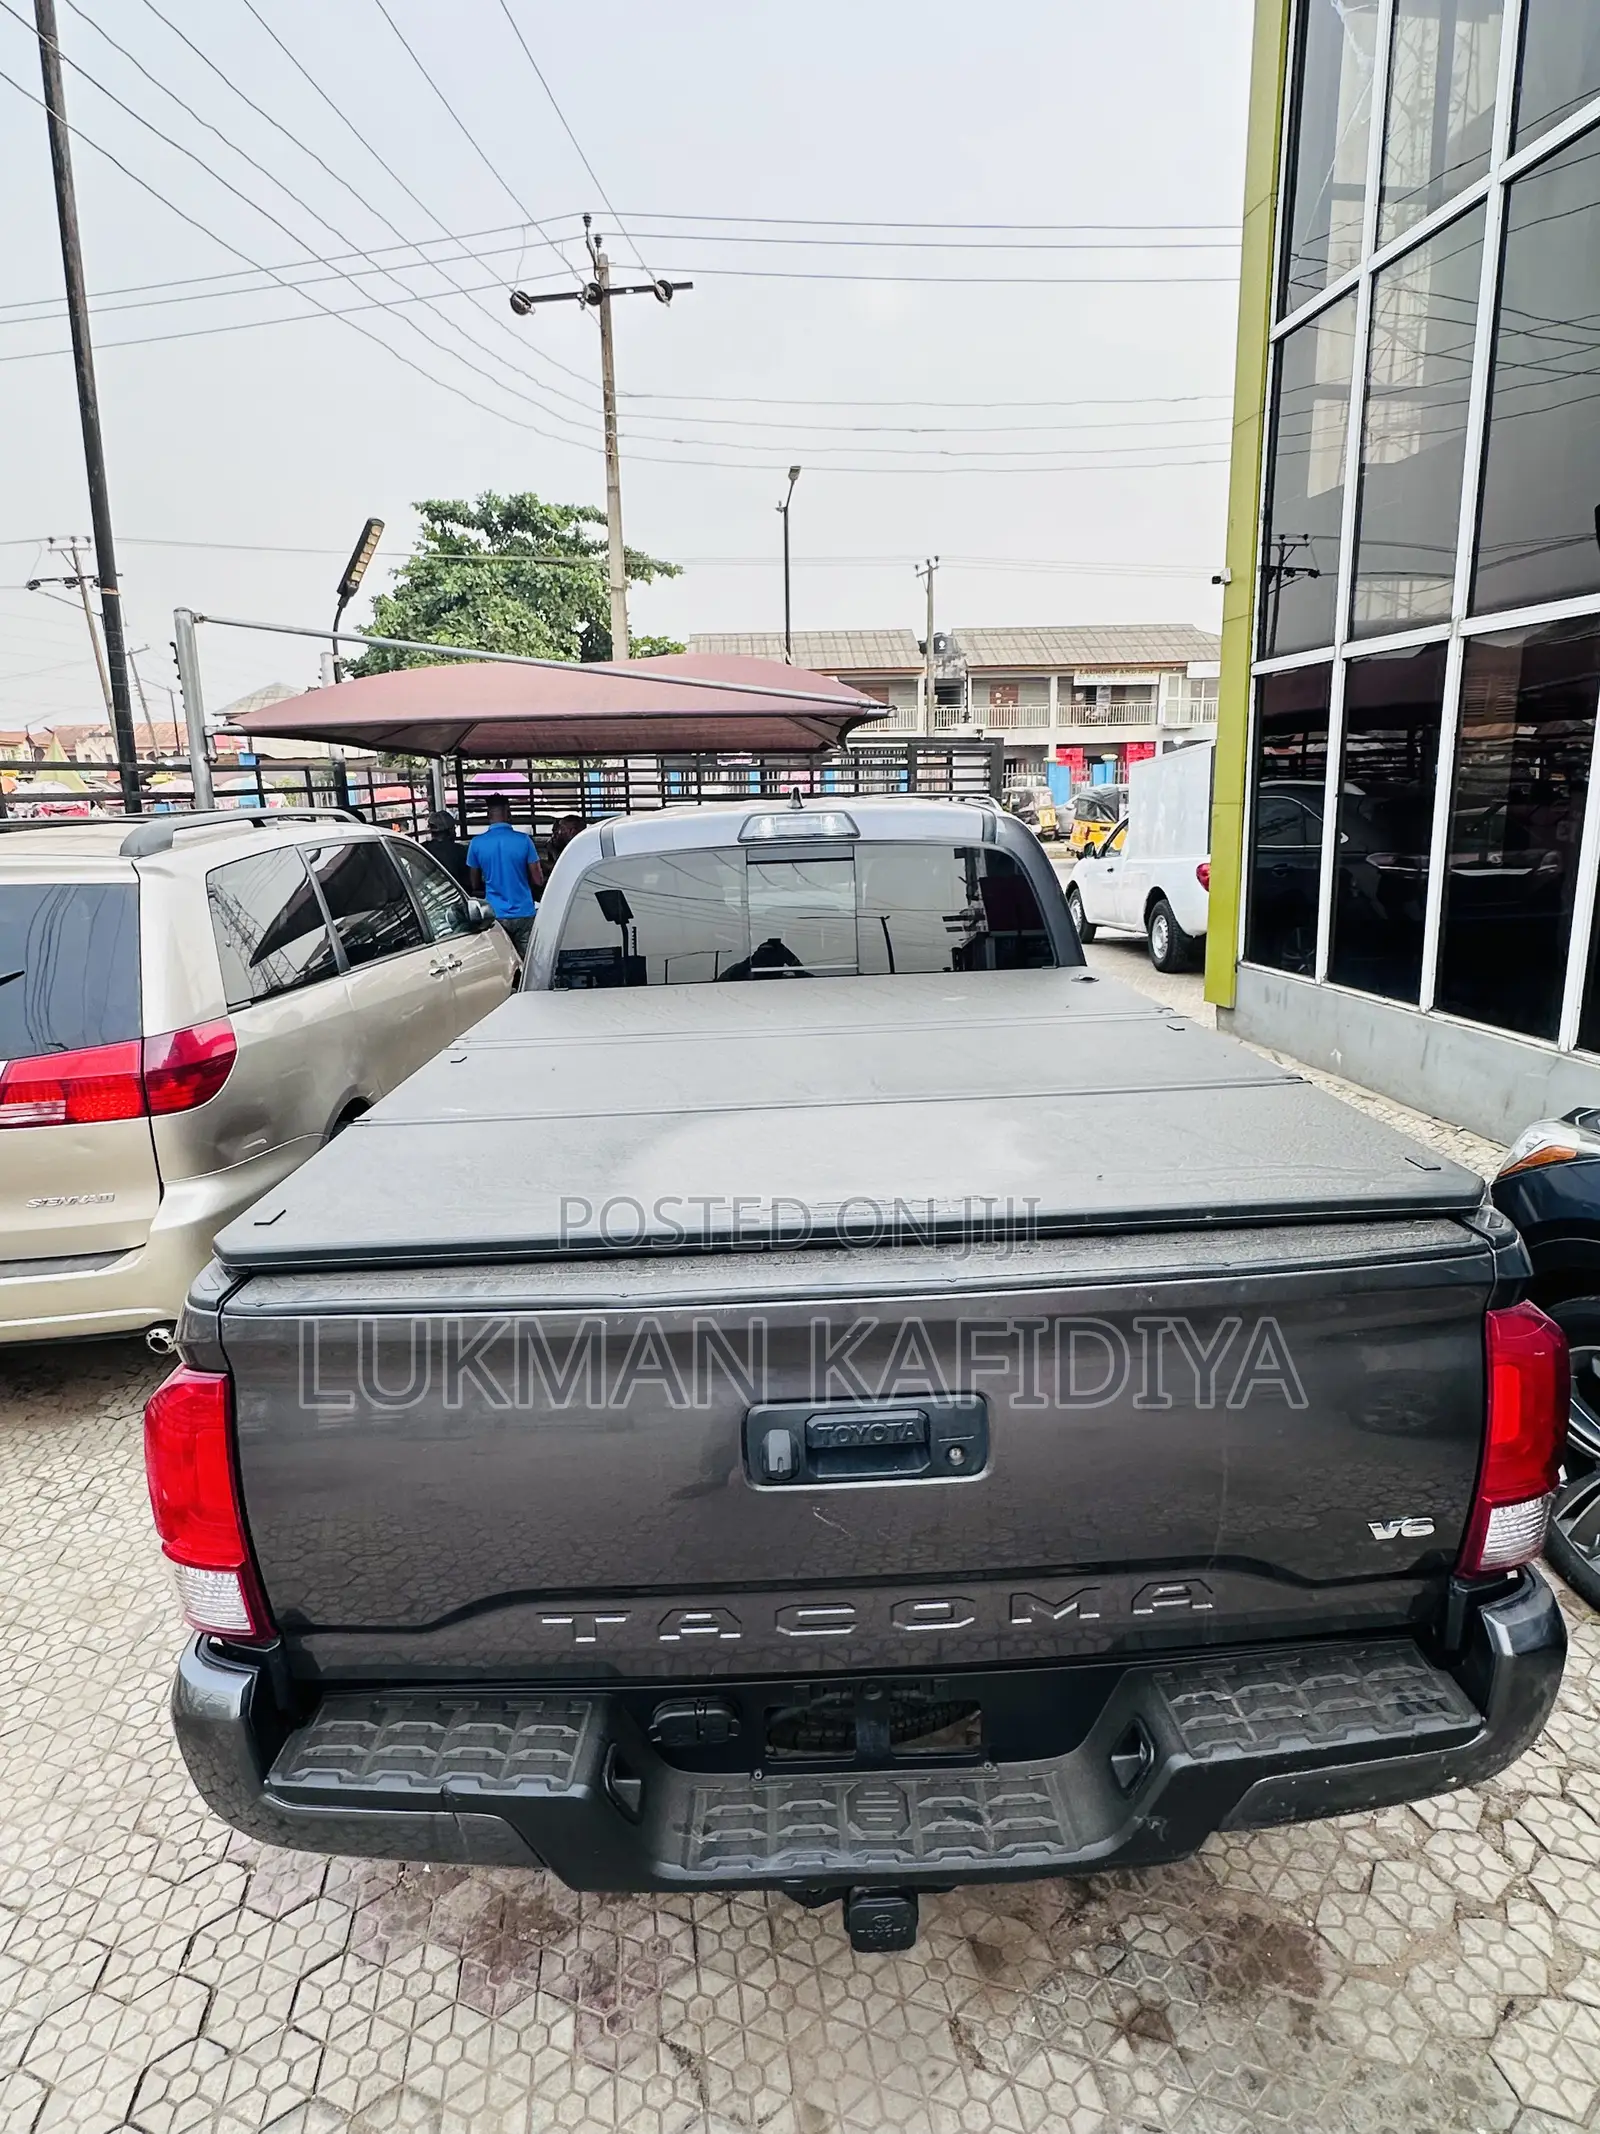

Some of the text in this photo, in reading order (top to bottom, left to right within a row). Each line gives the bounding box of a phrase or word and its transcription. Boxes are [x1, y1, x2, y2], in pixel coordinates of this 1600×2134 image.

[815, 1421, 921, 1445] TOYOTA
[1367, 1517, 1436, 1541] V6
[536, 1579, 1214, 1643] TACOMA
